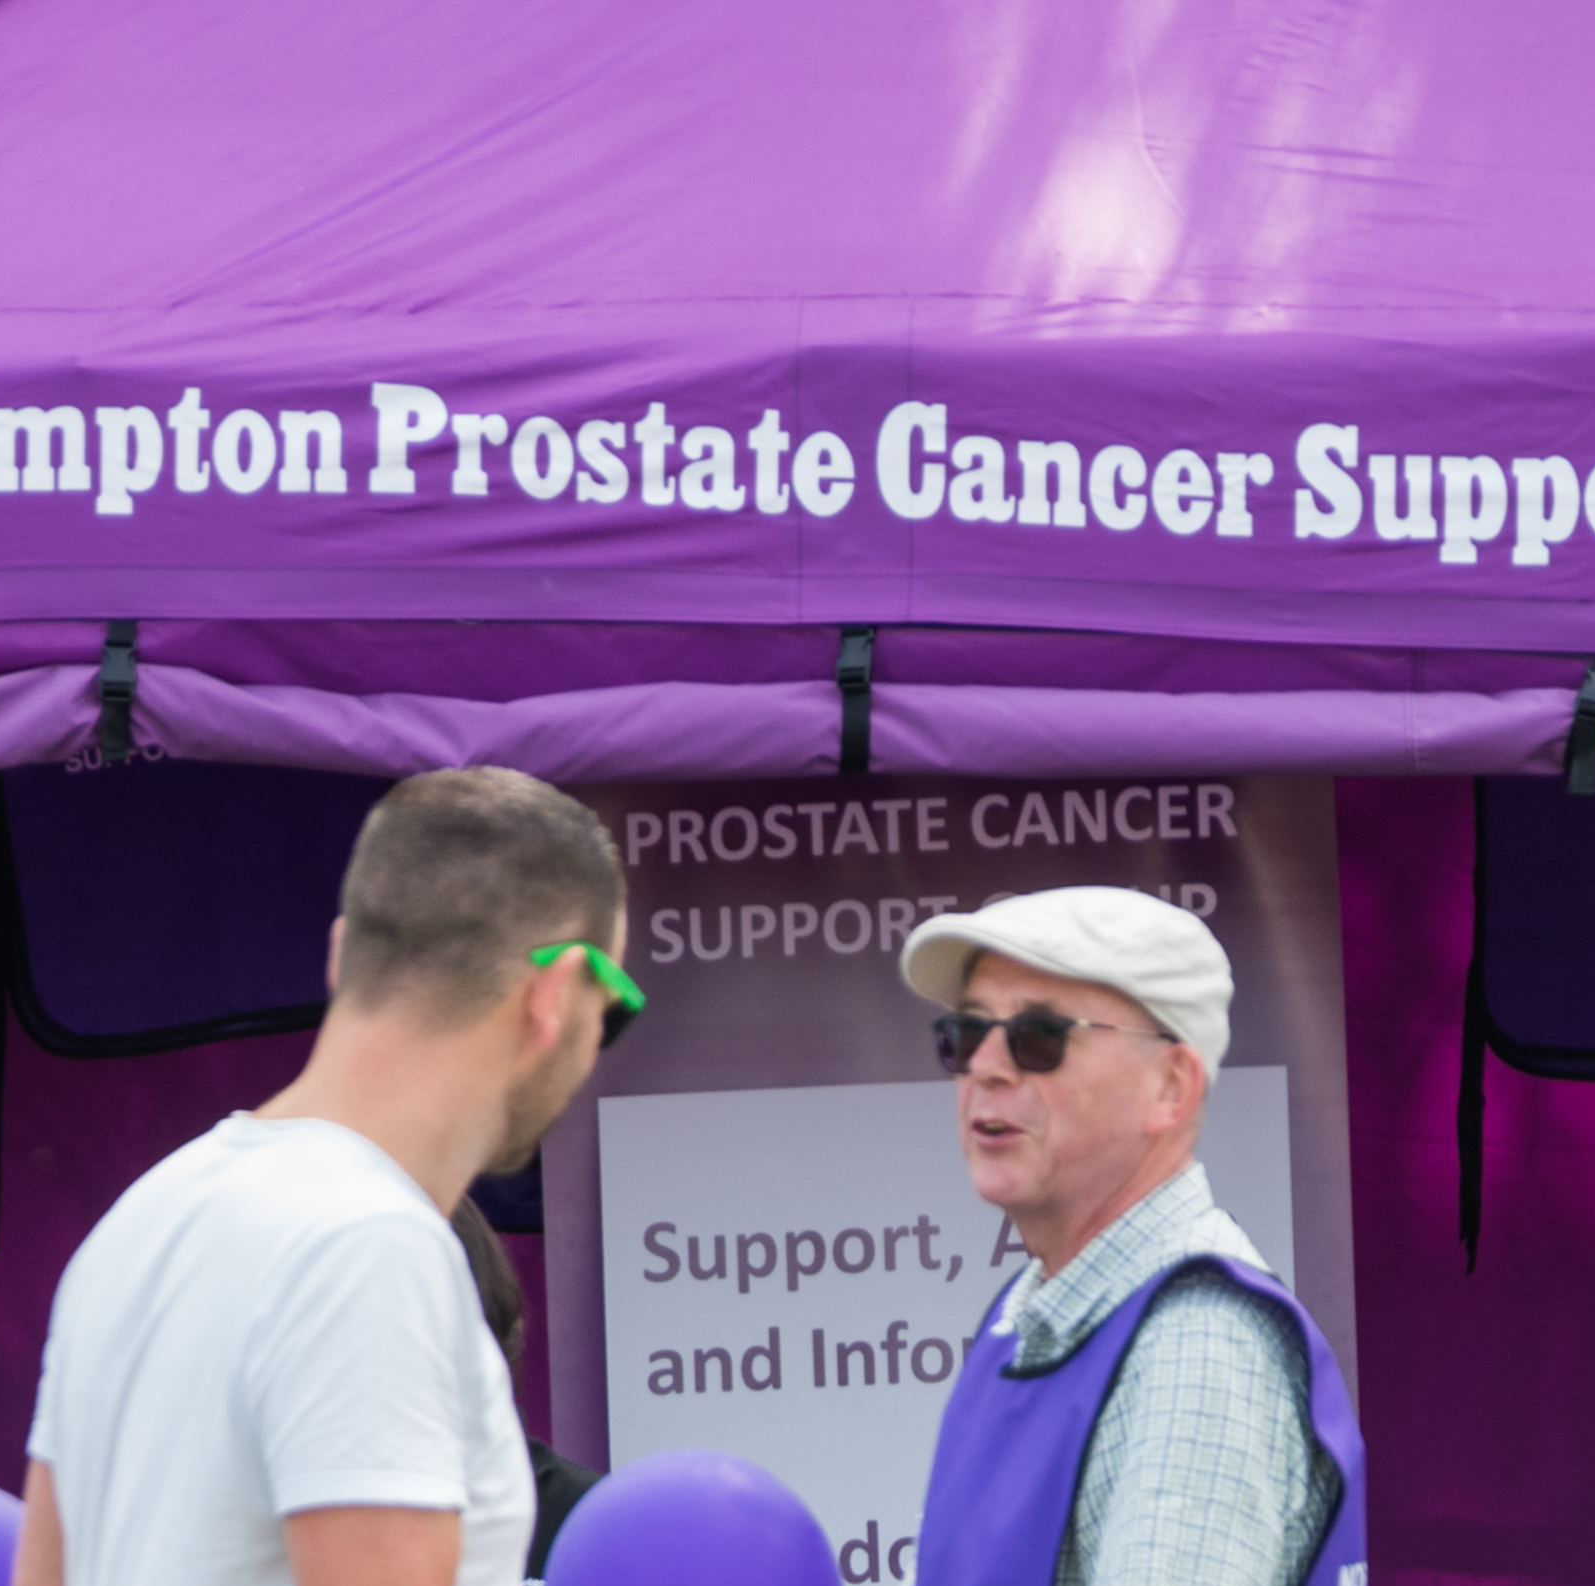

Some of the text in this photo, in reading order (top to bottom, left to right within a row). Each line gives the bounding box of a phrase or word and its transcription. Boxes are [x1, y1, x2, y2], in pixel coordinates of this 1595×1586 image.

[369, 382, 855, 517] Prostate
[876, 402, 1273, 537] Cancer
[625, 783, 1238, 866] PROSTATE CANCER
[642, 1214, 963, 1295] Support,
[647, 1328, 782, 1395] and
